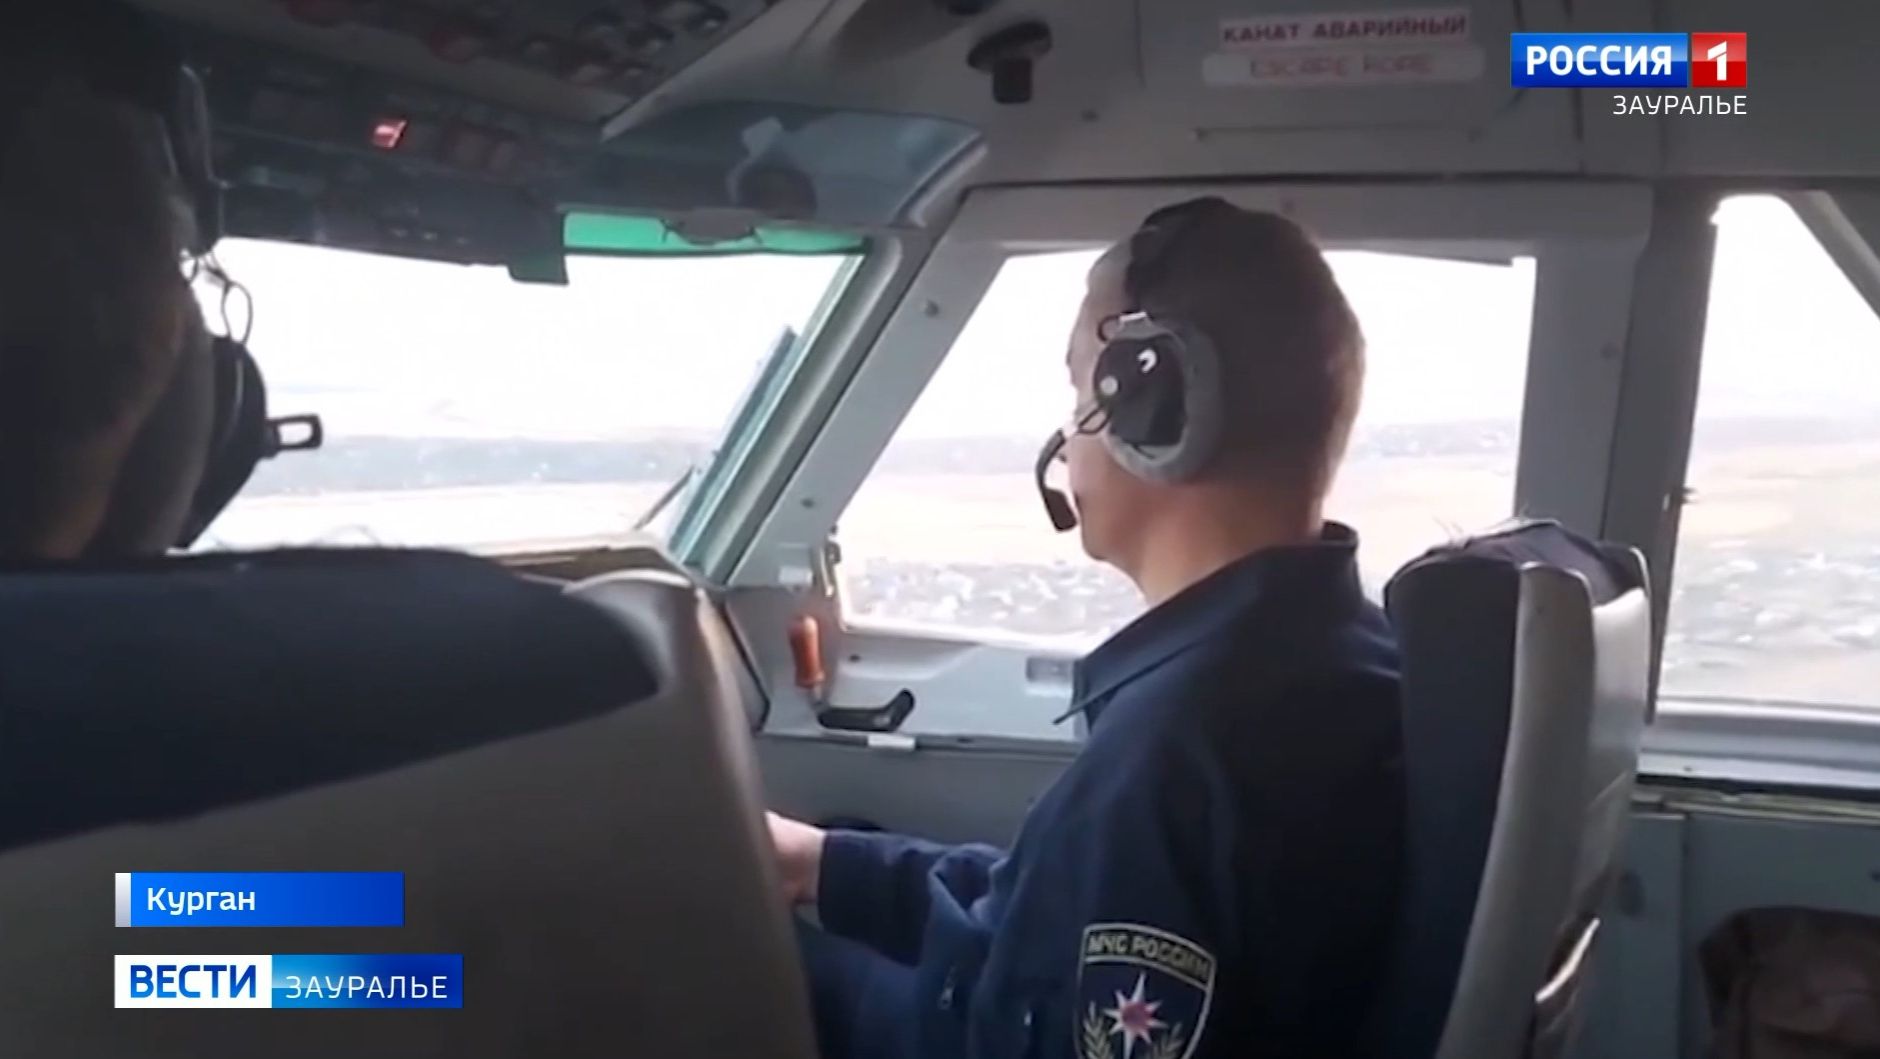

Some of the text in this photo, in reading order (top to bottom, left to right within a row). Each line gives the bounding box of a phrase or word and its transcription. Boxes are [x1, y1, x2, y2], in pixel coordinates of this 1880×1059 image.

[1223, 15, 1467, 43] КАНАТ АВАРИЙНЫЙ
[1087, 933, 1209, 978] МЧС РОССИИ
